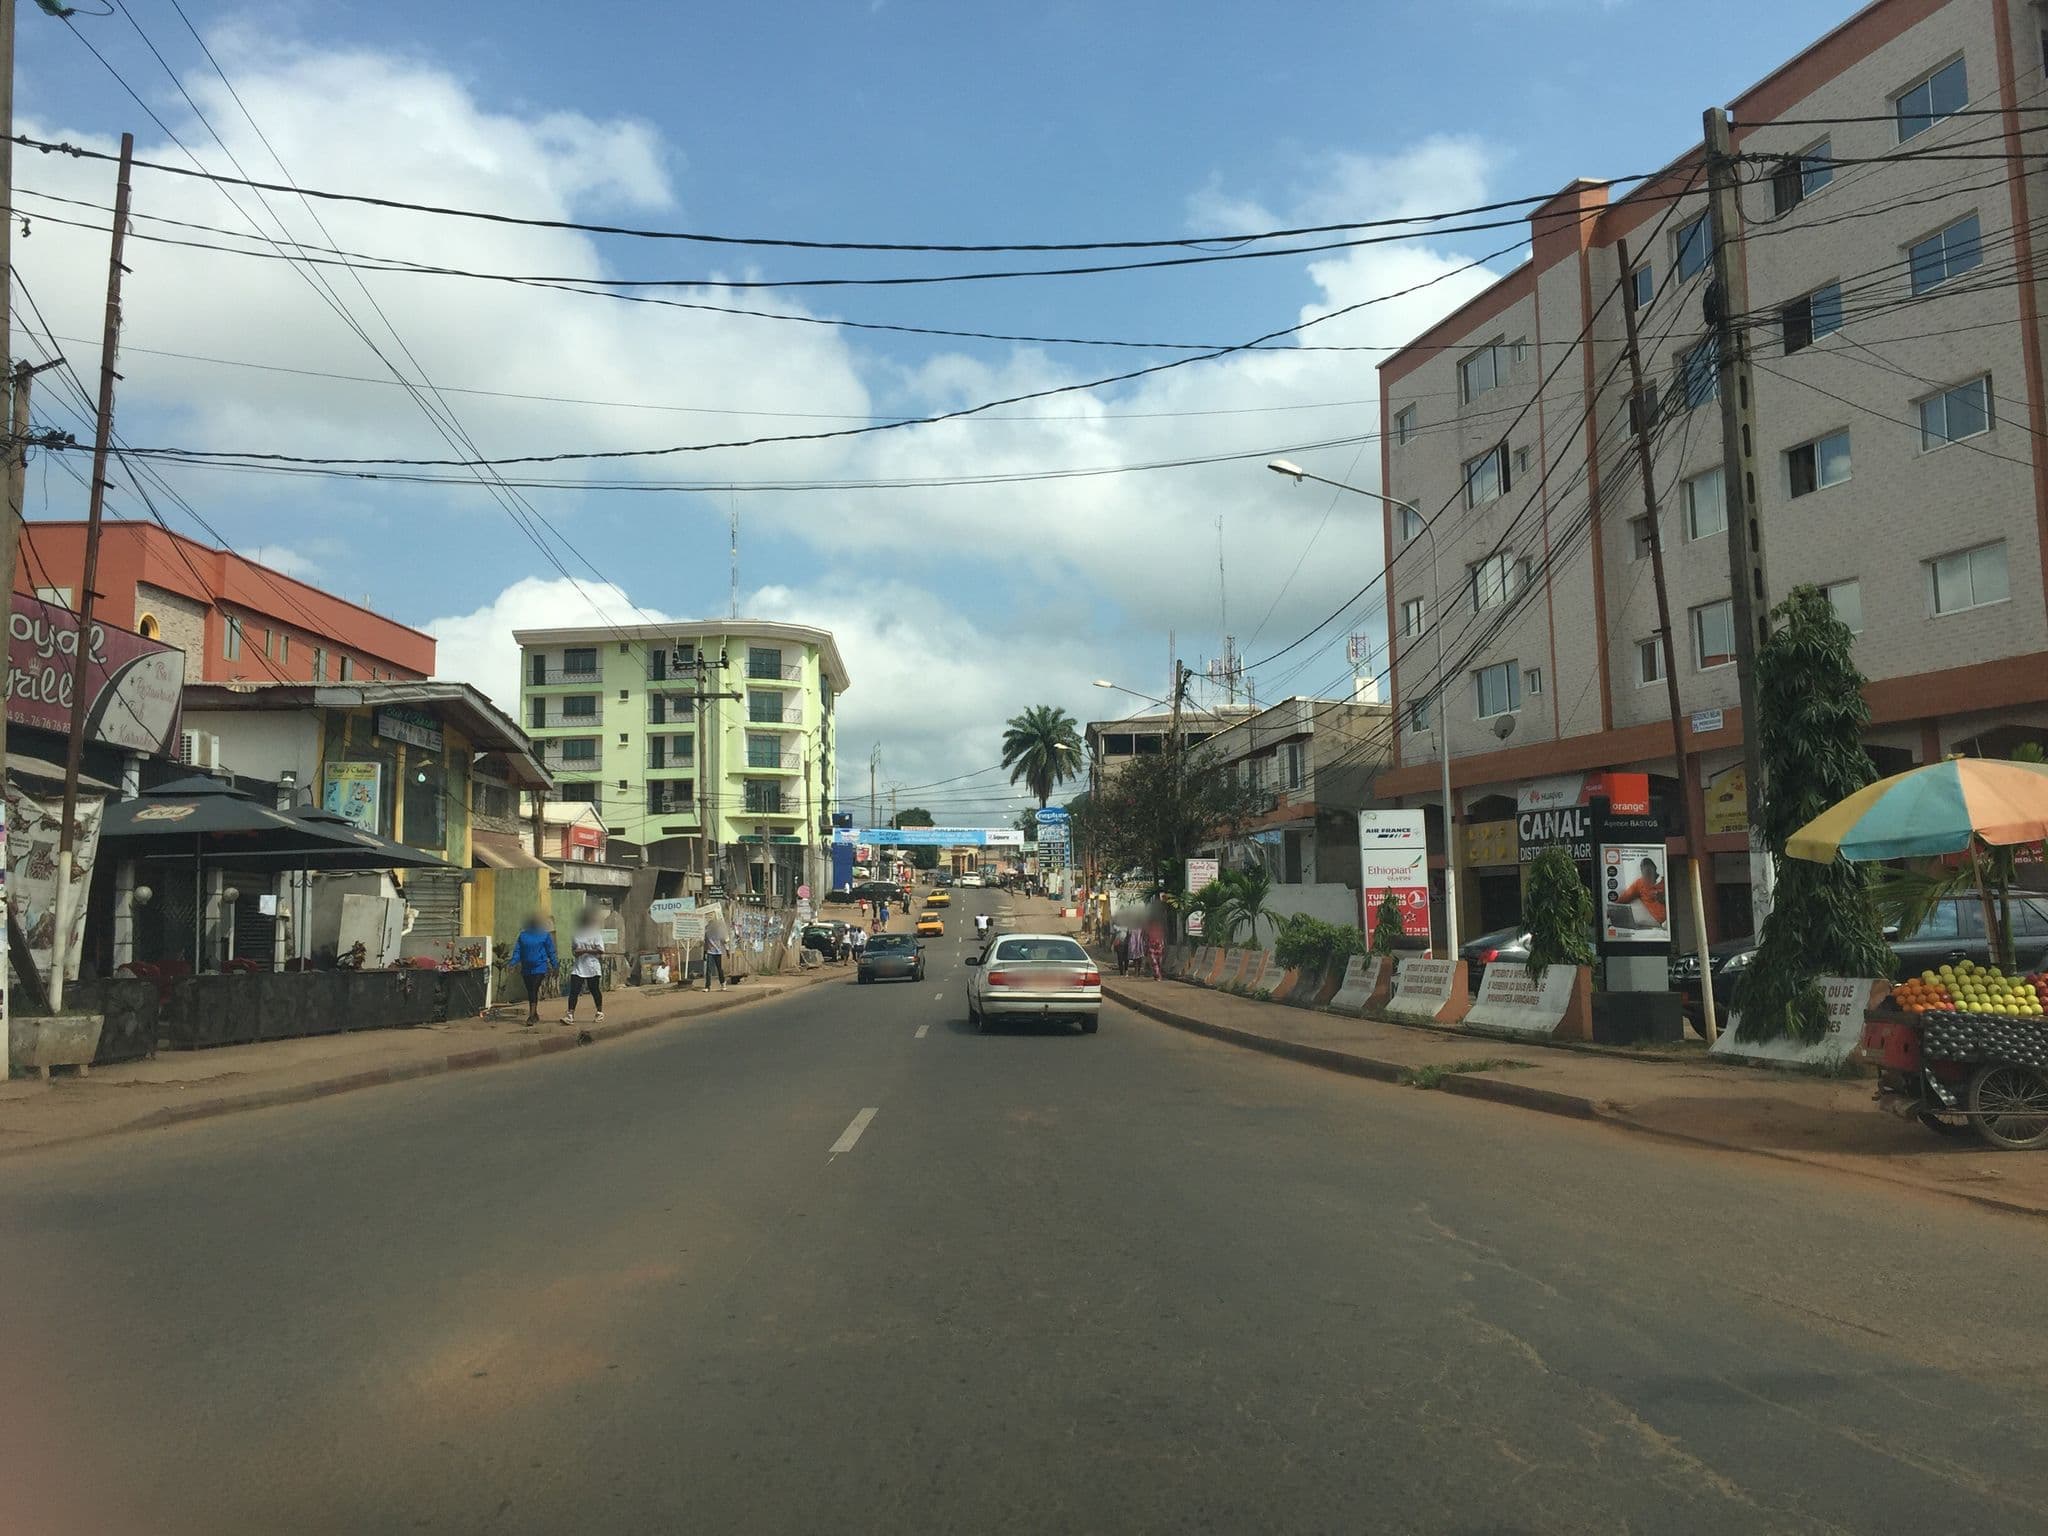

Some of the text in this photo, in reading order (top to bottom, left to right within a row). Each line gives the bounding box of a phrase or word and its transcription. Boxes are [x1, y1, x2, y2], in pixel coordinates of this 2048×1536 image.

[9, 612, 107, 664] oyal
[1613, 803, 1644, 812] orange
[1629, 820, 1658, 828] BASTOS
[1367, 866, 1411, 877] Ethiopian
[652, 902, 682, 911] STUDIO
[1828, 985, 1840, 998] OU
[1842, 985, 1855, 998] DE
[1840, 1003, 1851, 1016] DE
